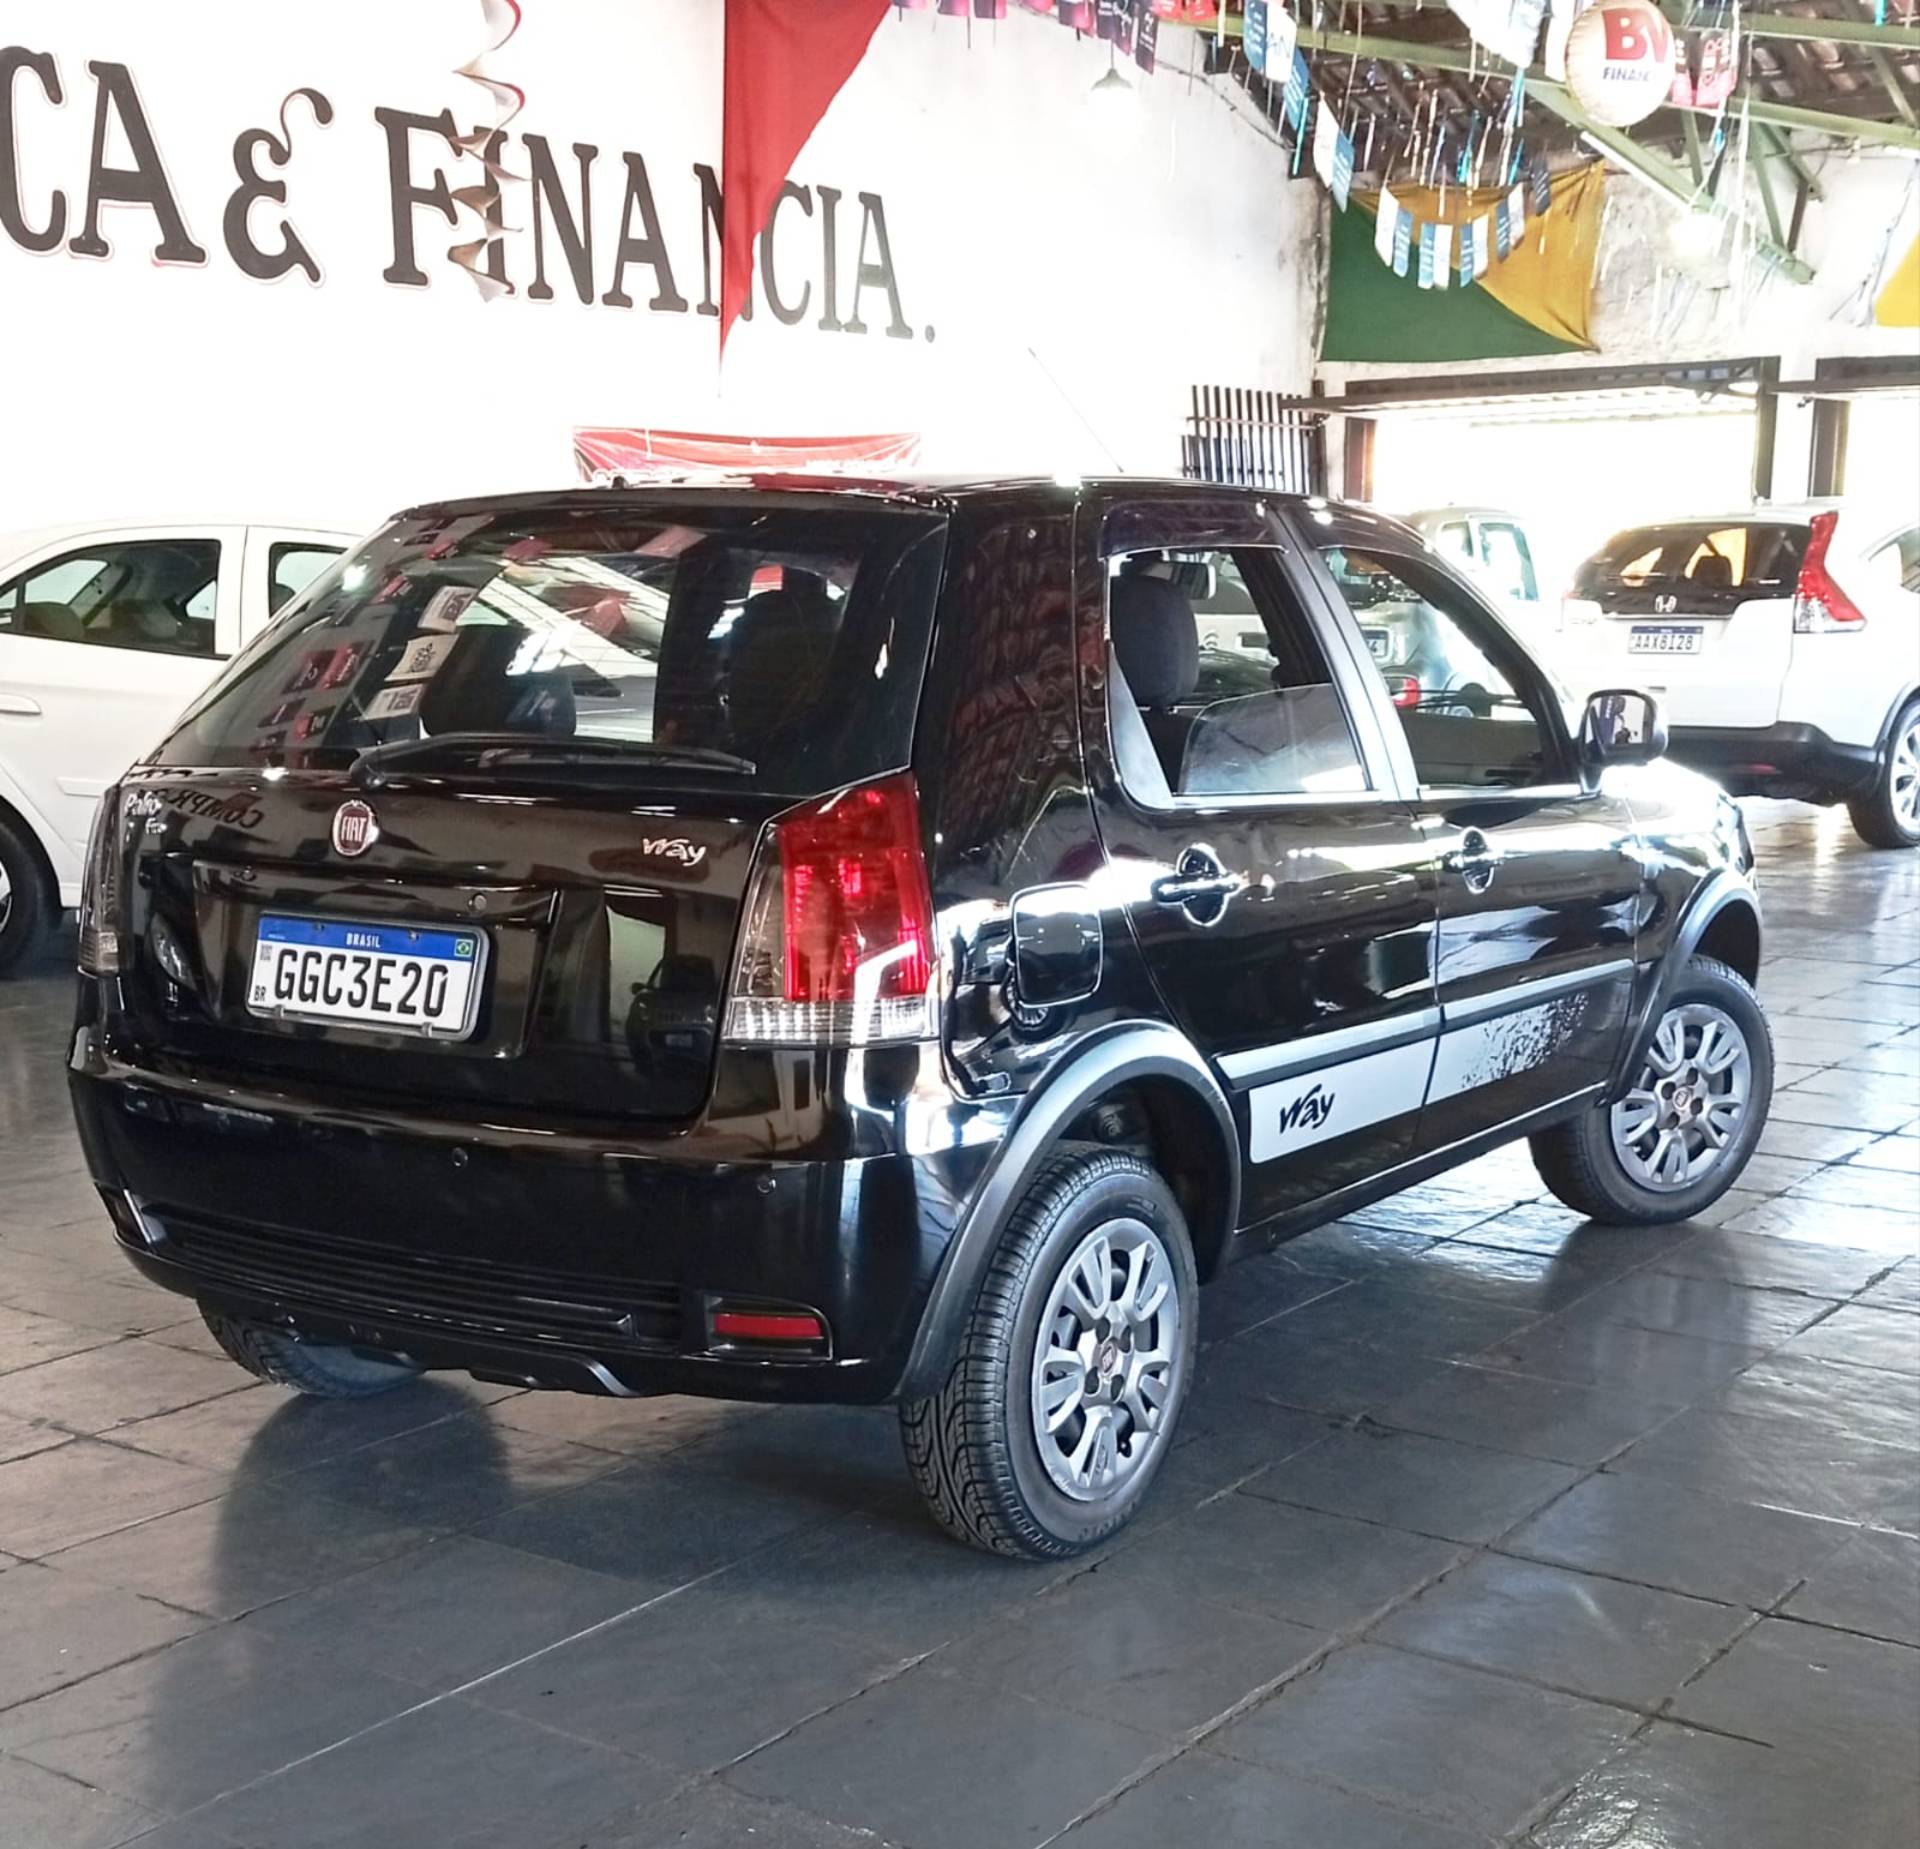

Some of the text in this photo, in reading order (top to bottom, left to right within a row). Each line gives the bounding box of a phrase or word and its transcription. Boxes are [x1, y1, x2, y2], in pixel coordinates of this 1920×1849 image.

[1602, 8, 1669, 63] BV
[223, 88, 333, 287] &
[341, 815, 367, 842] FIAT
[346, 932, 381, 949] BRASIL
[254, 985, 266, 1002] BR
[274, 948, 449, 1018] GGC3E20
